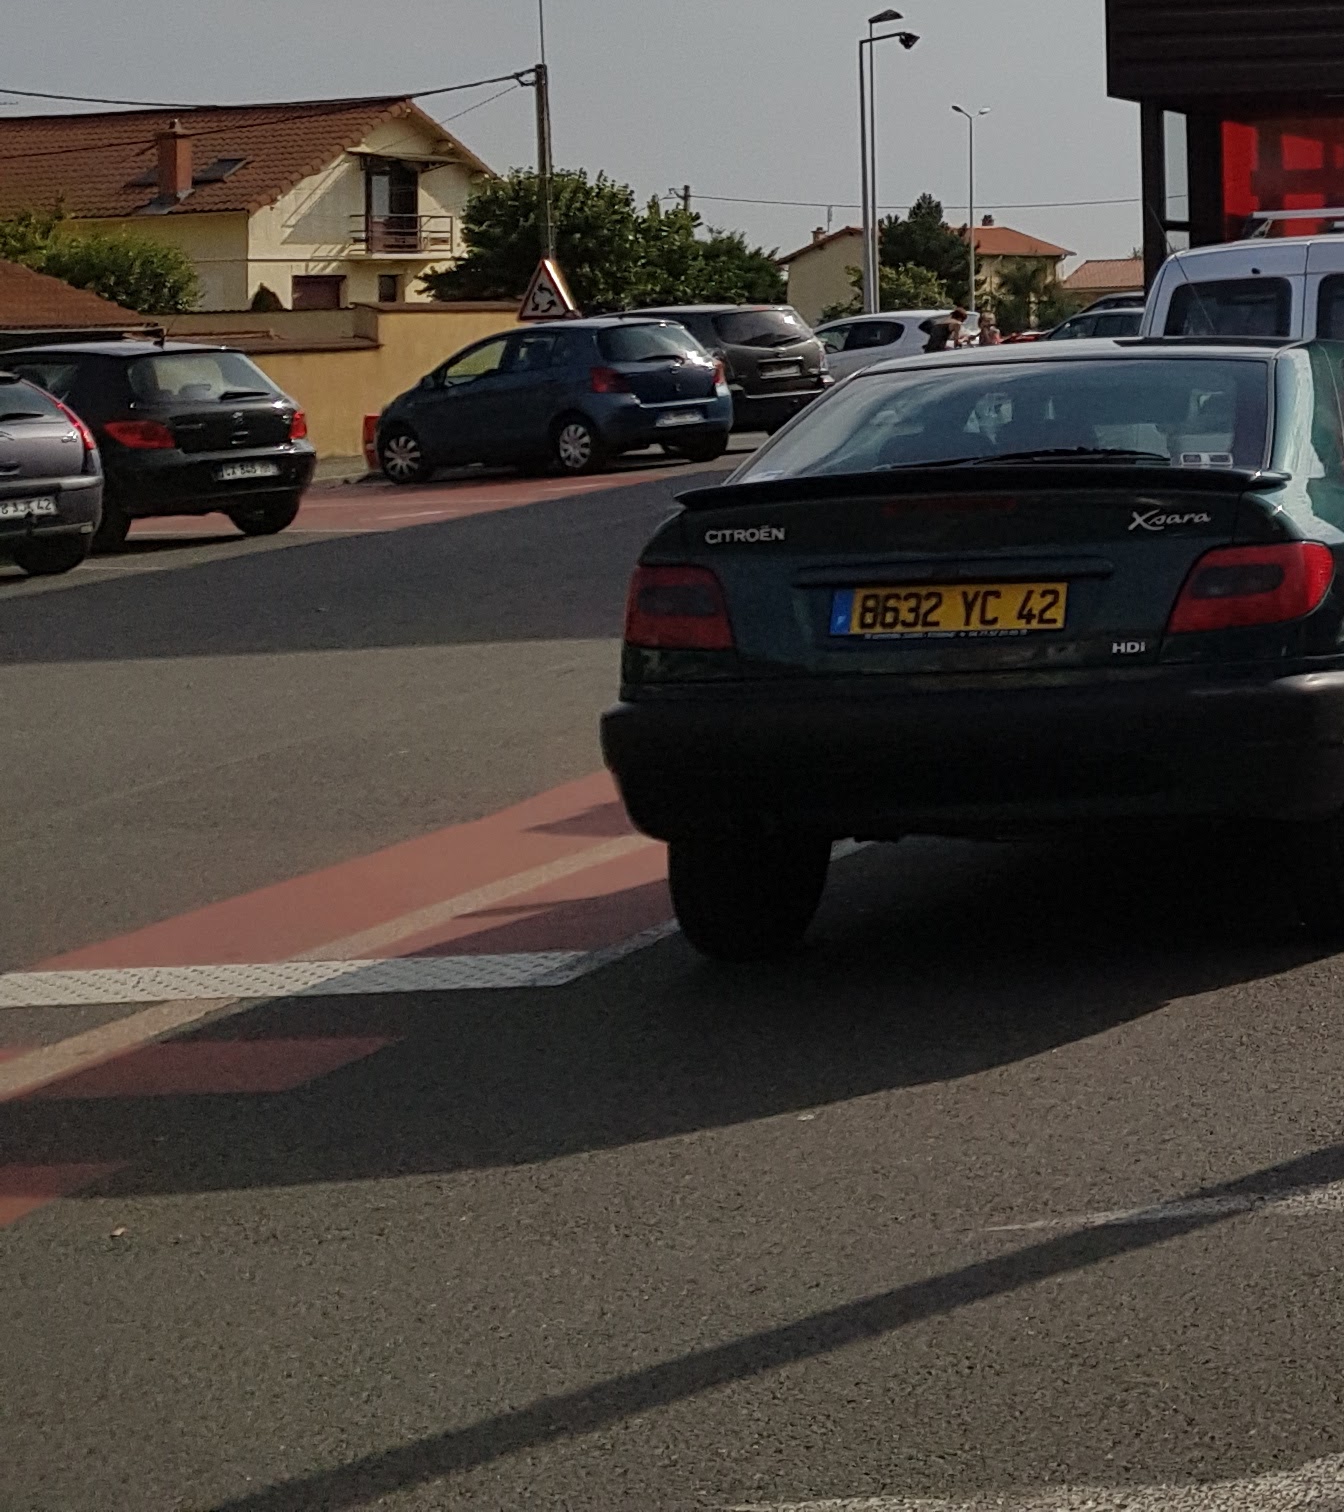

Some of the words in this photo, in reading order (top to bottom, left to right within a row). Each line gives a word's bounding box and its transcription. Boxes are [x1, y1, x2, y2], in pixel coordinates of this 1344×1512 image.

[1128, 509, 1212, 532] Xsara
[705, 524, 786, 545] CITROËN
[860, 591, 943, 629] 8632
[961, 590, 1001, 627] YC
[1016, 589, 1060, 625] 42
